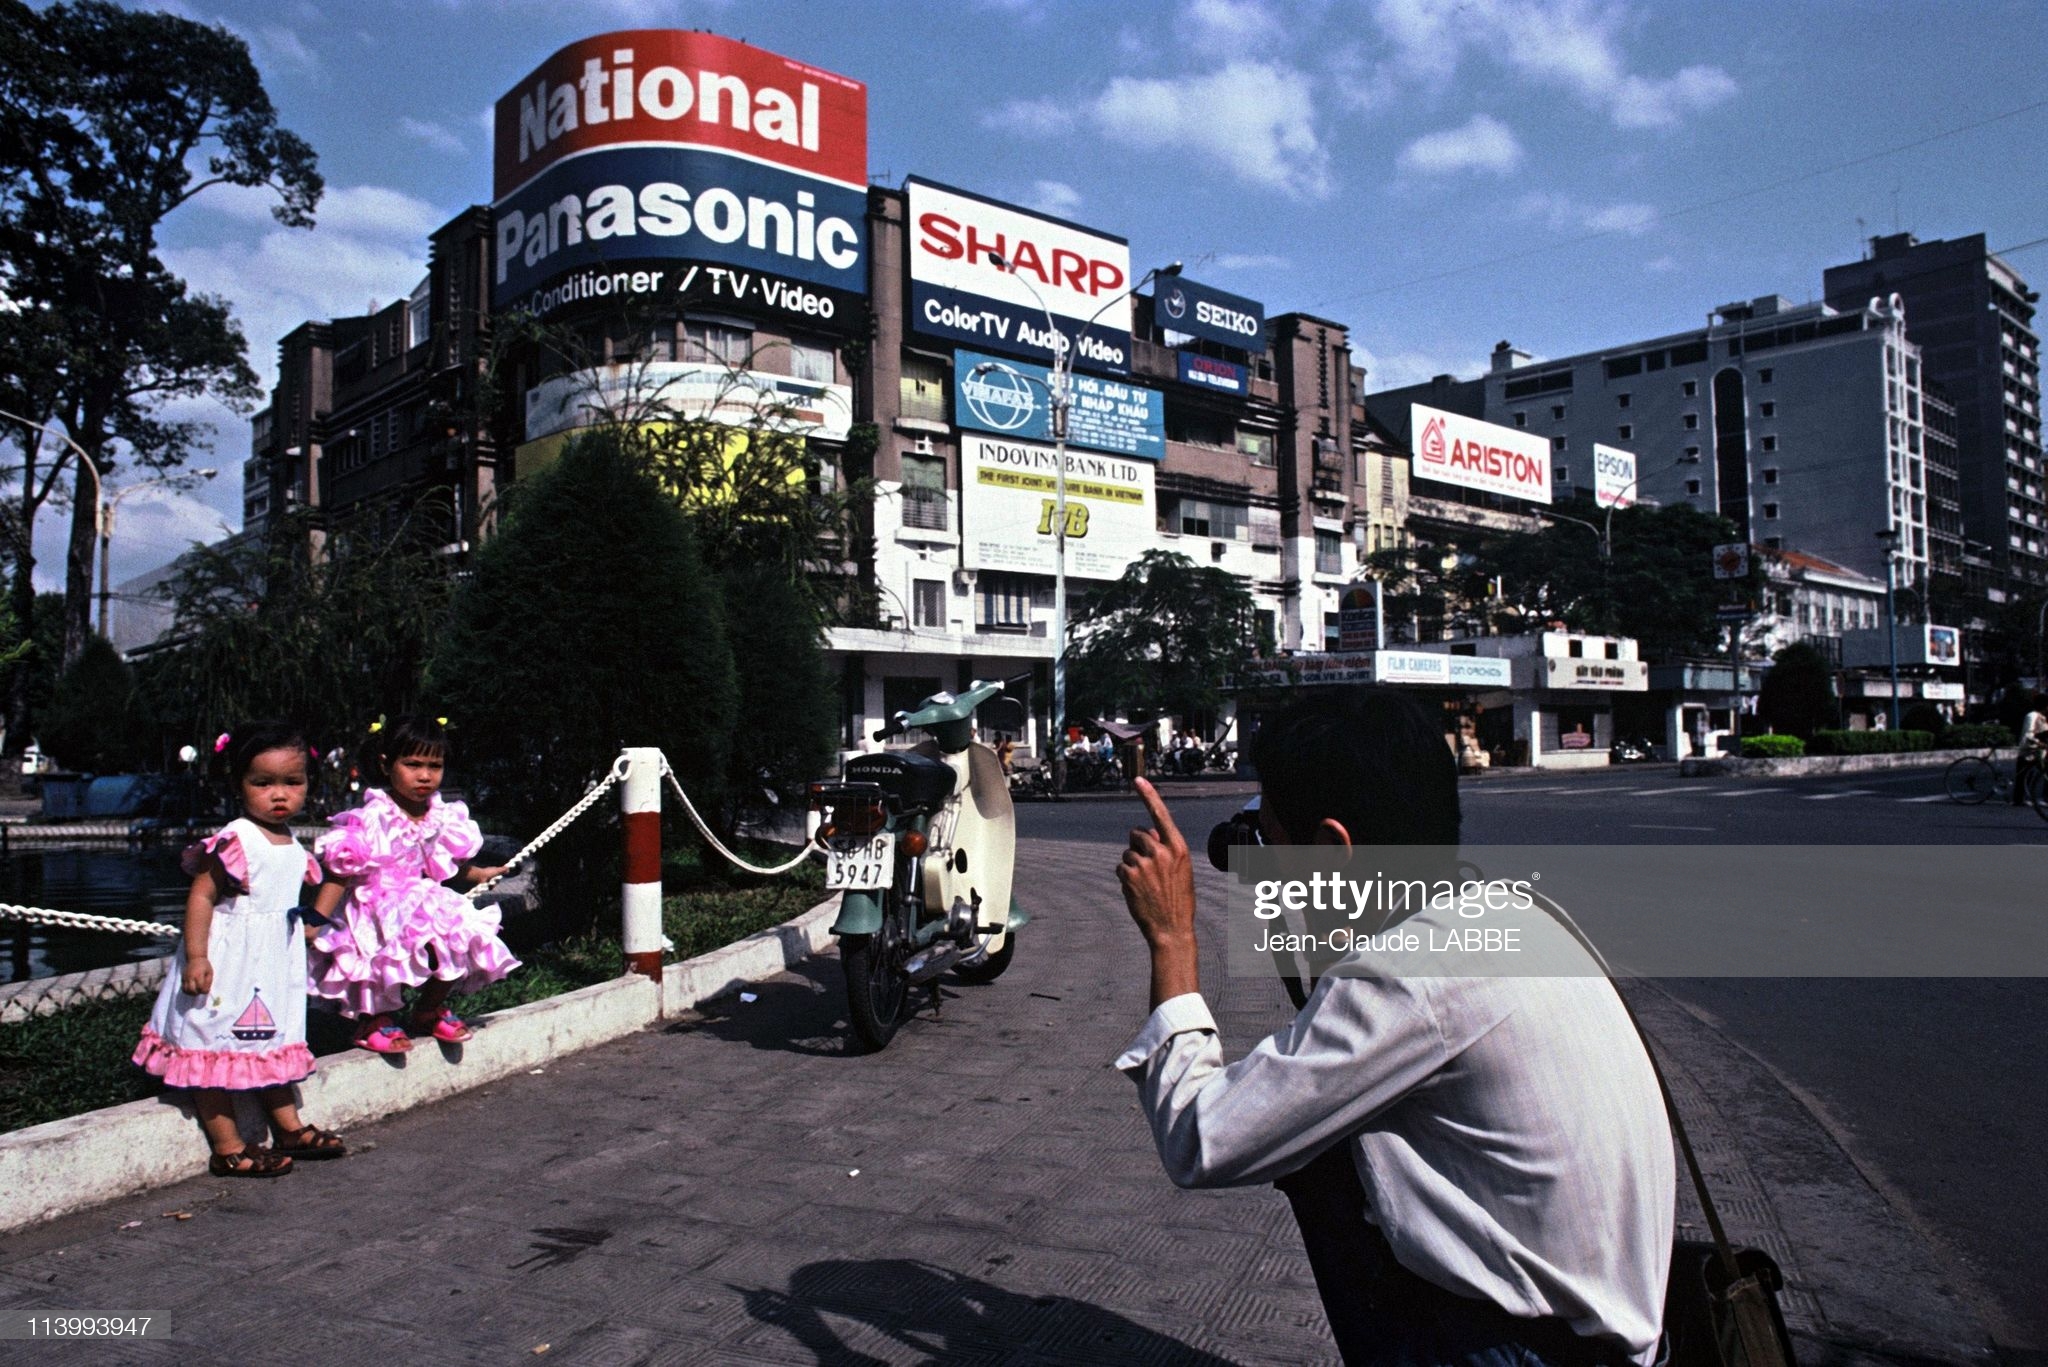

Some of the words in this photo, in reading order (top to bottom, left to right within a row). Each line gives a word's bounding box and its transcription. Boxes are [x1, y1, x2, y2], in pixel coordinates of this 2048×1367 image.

[518, 48, 820, 163] National
[496, 182, 860, 285] Panasonic
[918, 212, 1124, 298] SHARP
[530, 268, 664, 320] Conditioner
[1196, 301, 1258, 337] SEIKO
[1016, 320, 1070, 354] Audo
[1077, 335, 1124, 364] Video
[979, 442, 1061, 469] INDOVINA
[1065, 456, 1107, 477] BANK
[1111, 464, 1141, 482] LTD.
[1450, 438, 1543, 486] ARISTON
[1597, 453, 1634, 481] EPSON
[1045, 479, 1081, 493] VETURE
[1387, 657, 1406, 671] FILM
[1408, 658, 1442, 673] CAMERAS
[851, 766, 904, 776] HONDA
[835, 863, 882, 885] 5947
